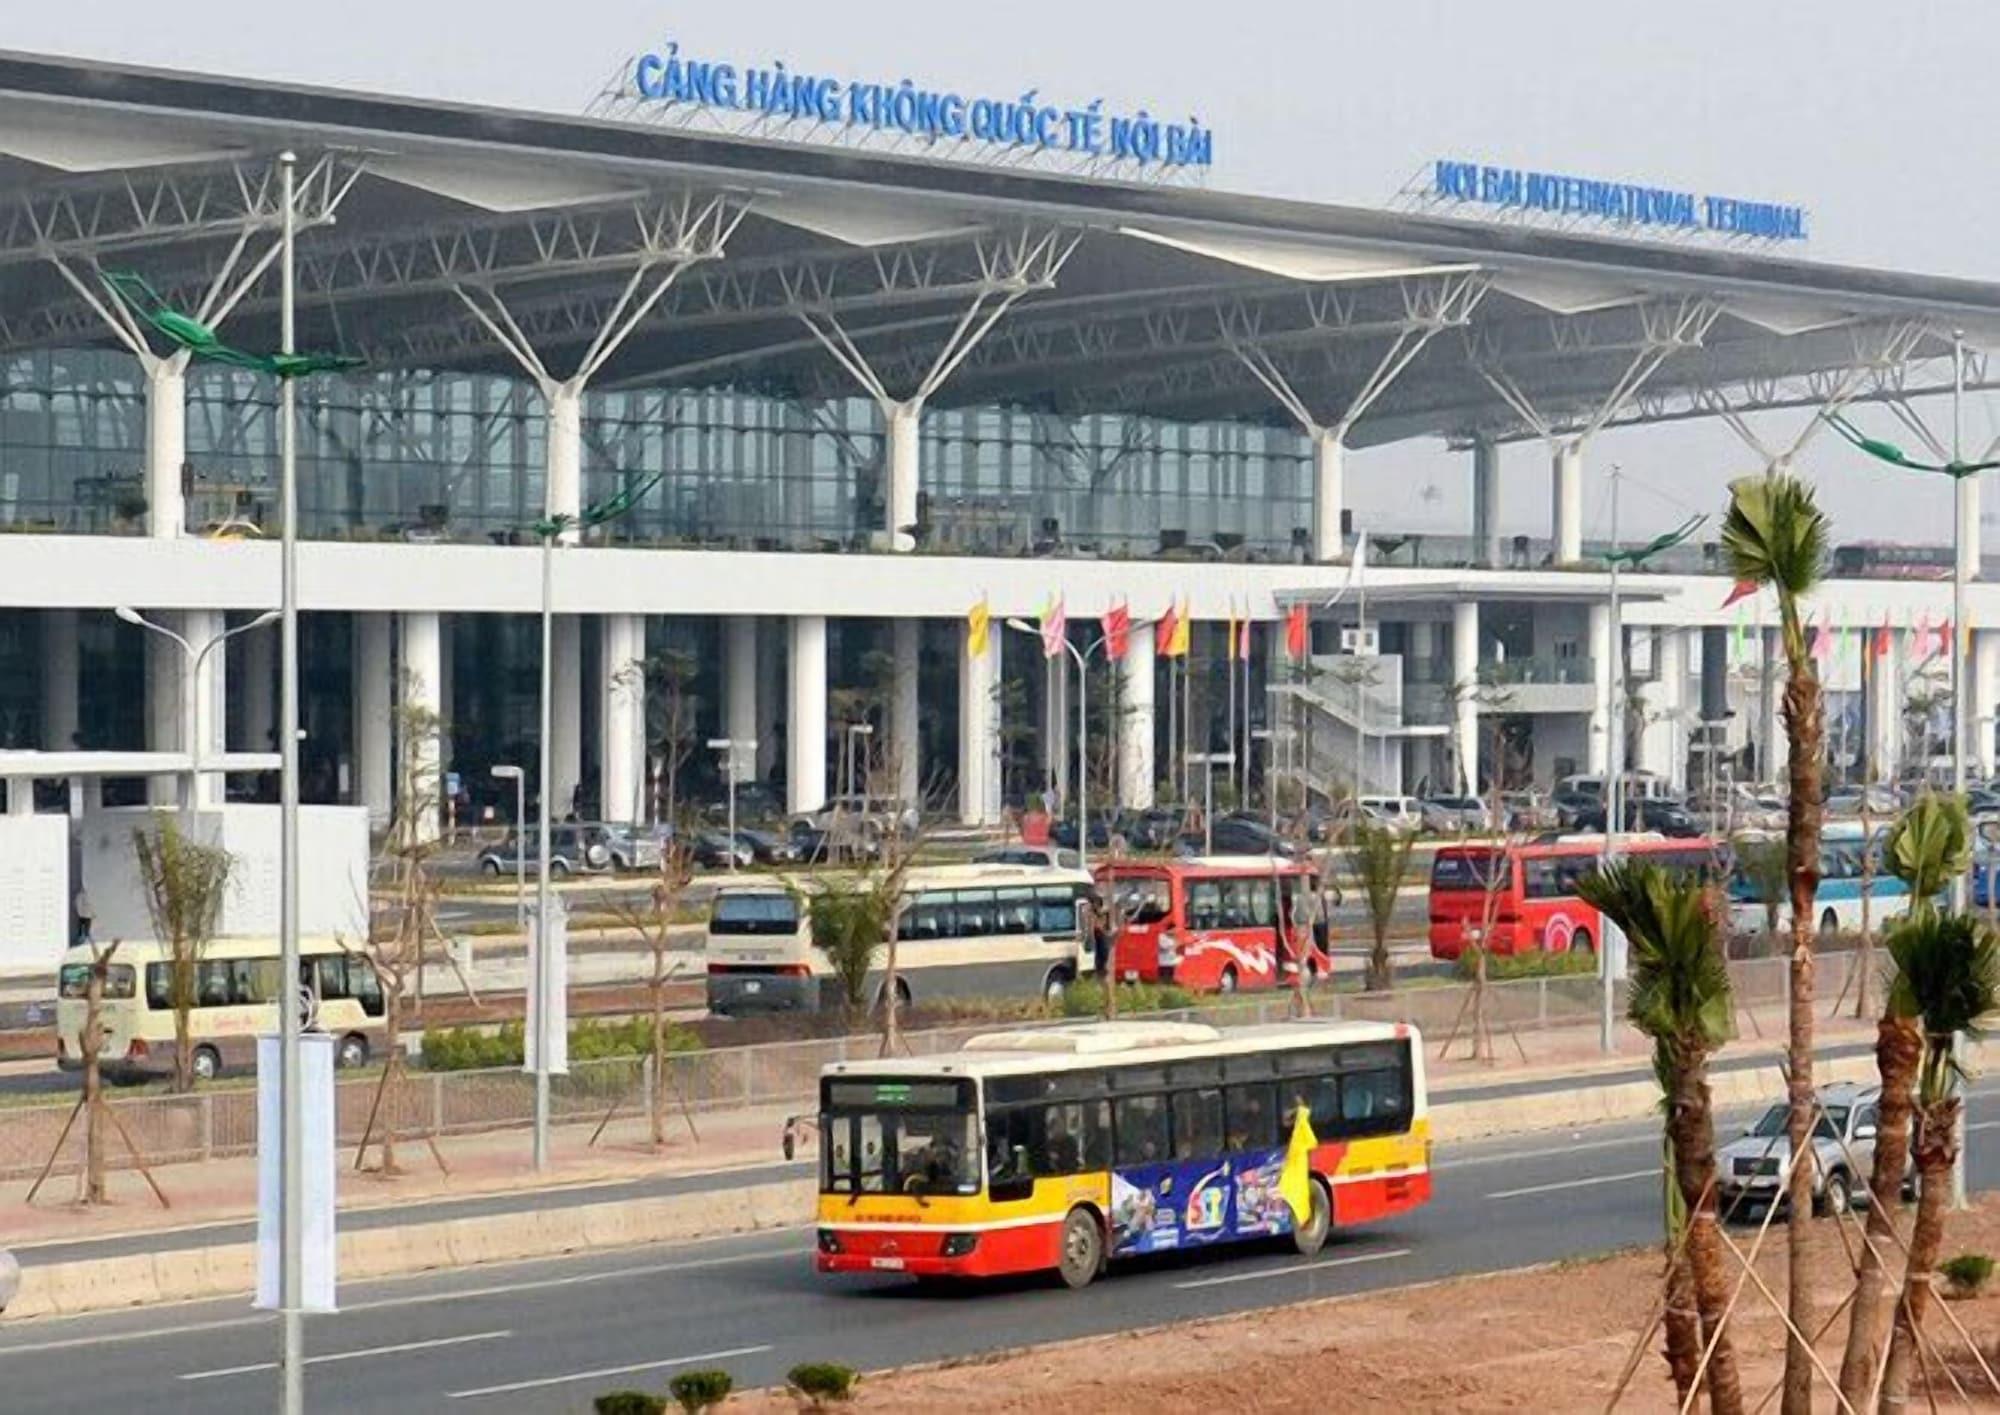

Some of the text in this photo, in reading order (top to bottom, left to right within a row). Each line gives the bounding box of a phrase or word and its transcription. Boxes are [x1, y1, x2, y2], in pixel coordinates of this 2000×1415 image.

[637, 42, 737, 107] CẢNG
[747, 61, 841, 122] HÀNG
[849, 79, 963, 136] KHÔNG
[971, 89, 1059, 147] QUỐC
[1065, 99, 1104, 150] TẾ
[1524, 172, 1697, 228] INTERNATIONAL
